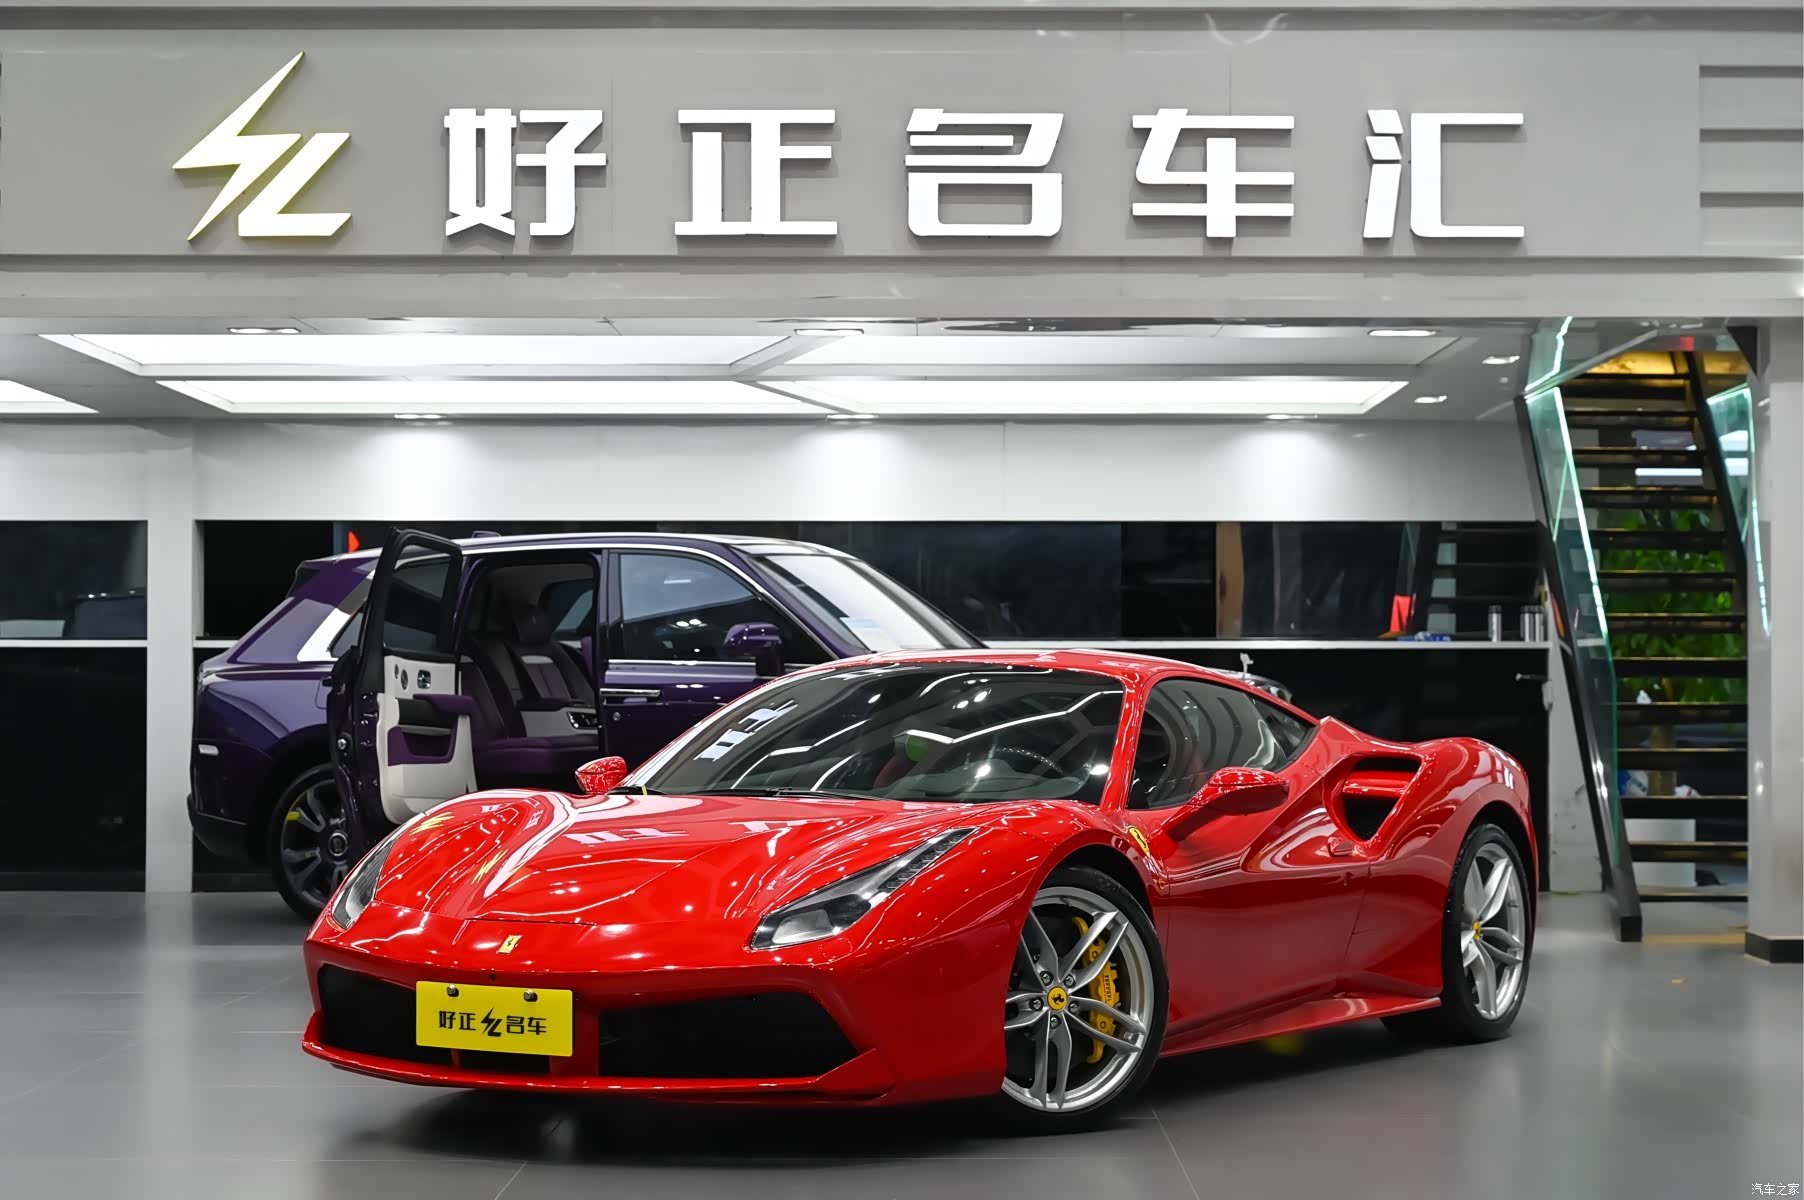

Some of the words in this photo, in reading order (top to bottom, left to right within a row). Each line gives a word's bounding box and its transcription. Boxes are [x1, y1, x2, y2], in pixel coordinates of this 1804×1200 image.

[444, 108, 1525, 238] 好正名车汇
[438, 1010, 476, 1031] 好正
[506, 1015, 547, 1036] 名车
